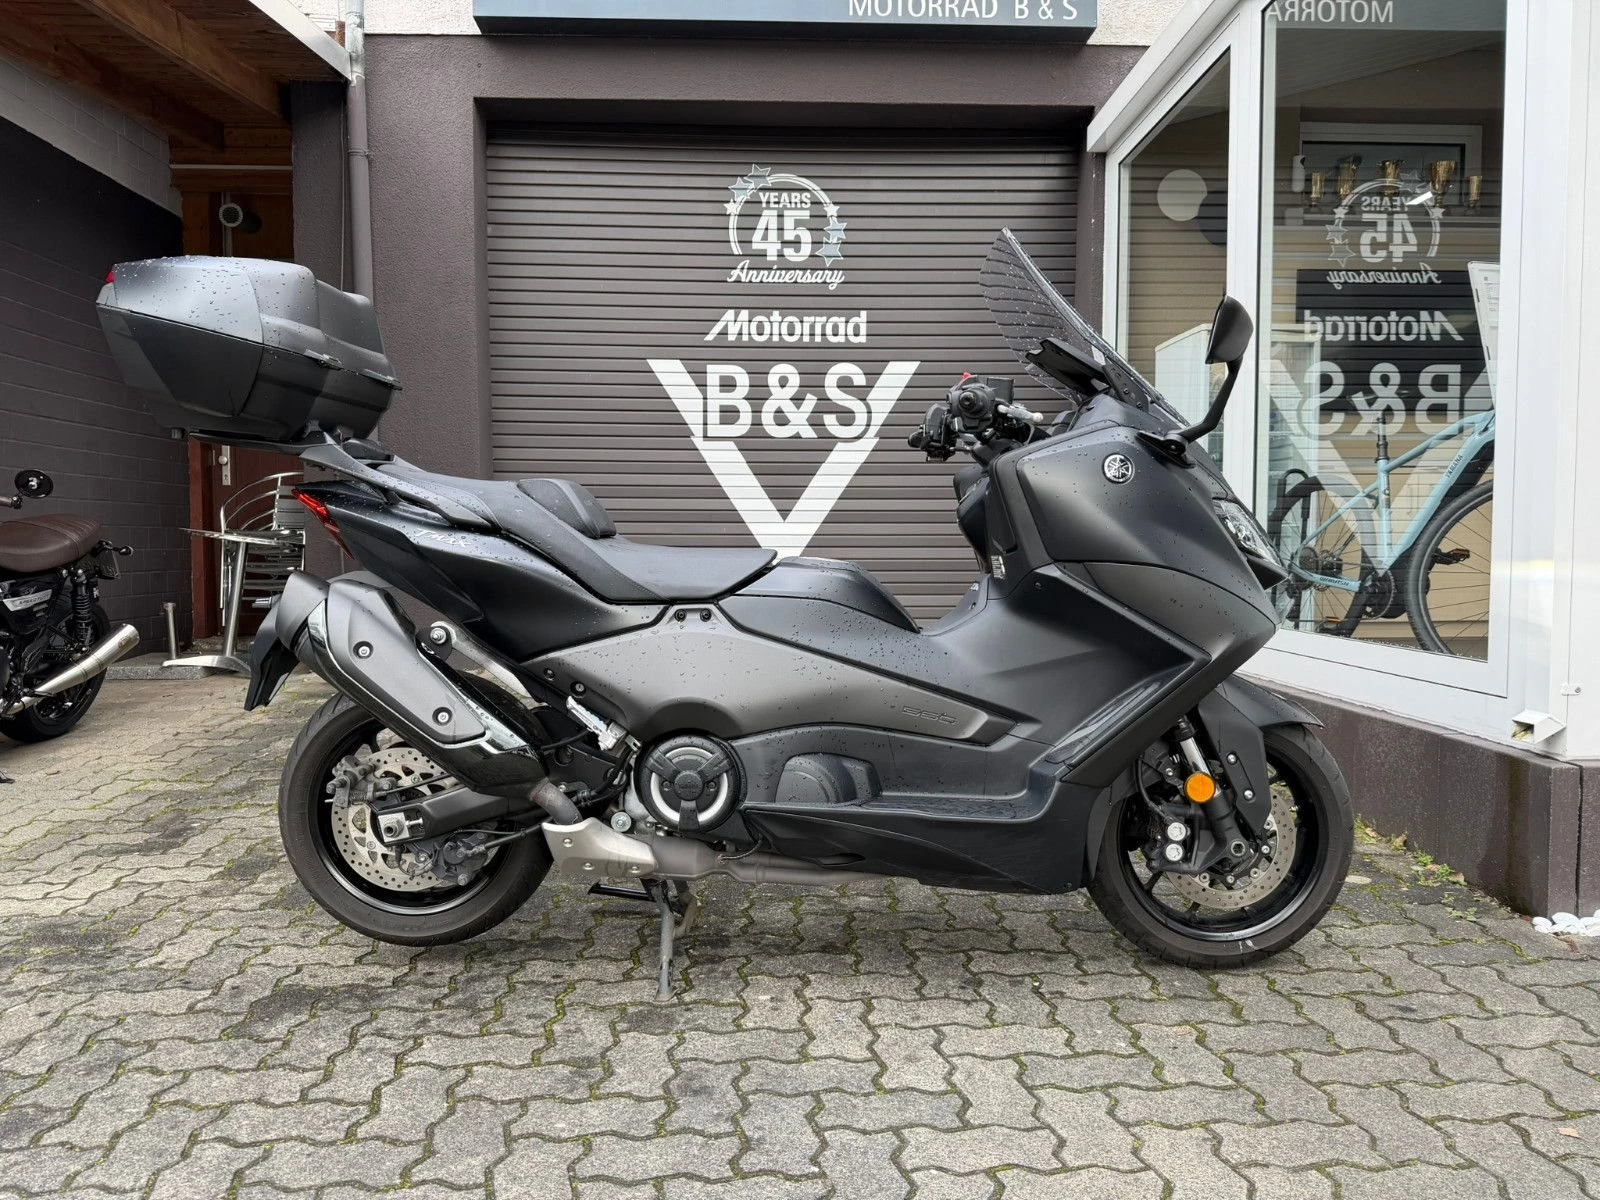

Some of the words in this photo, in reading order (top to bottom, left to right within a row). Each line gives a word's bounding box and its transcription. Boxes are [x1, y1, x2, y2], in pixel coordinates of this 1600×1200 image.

[1014, 0, 1029, 19] B
[1038, 0, 1054, 20] &
[1062, 0, 1078, 21] S
[759, 192, 811, 209] YEARS
[752, 209, 812, 262] 45
[727, 259, 845, 291] Anniversary
[704, 309, 868, 343] Motorrad
[706, 362, 868, 439] B&S
